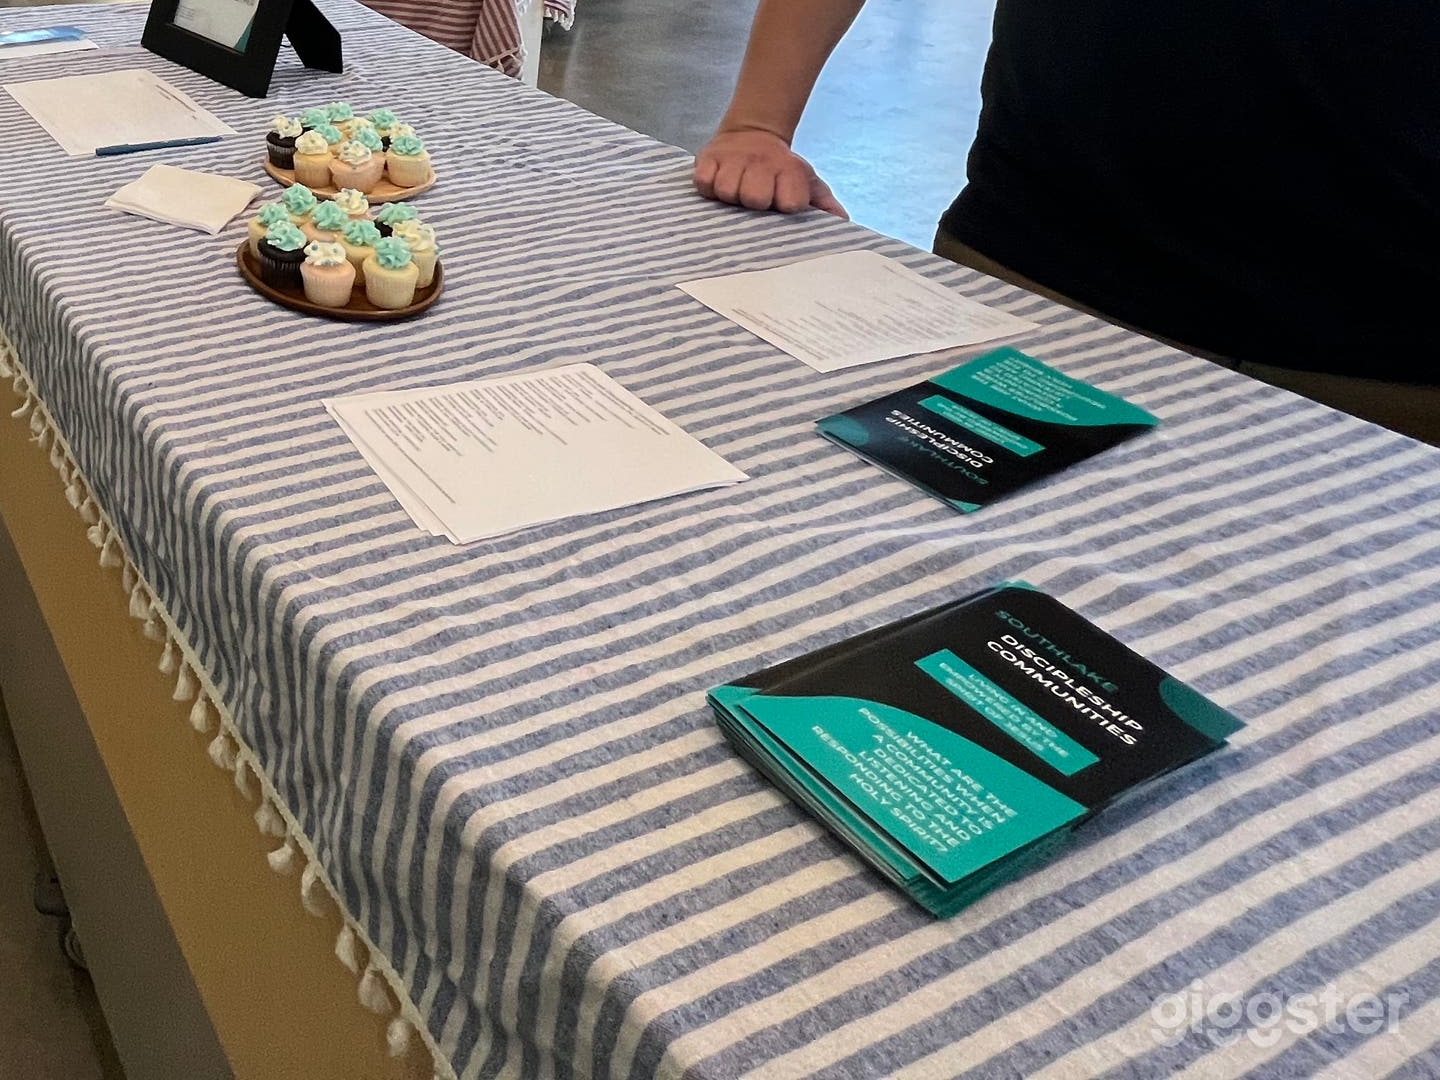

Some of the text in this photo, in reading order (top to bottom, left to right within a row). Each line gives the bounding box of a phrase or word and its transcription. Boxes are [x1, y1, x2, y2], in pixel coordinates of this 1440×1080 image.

[882, 414, 985, 468] DISCIPLESHIP
[888, 408, 996, 464] COMMUNITIES
[982, 639, 1140, 746] COMMUNITIES
[993, 609, 1120, 693] SOUTHLAKE
[998, 633, 1145, 732] DISCIPLESHIP
[936, 661, 1023, 723] EMPOWERED
[1040, 737, 1070, 758] THE
[1023, 715, 1059, 739] AND
[809, 724, 961, 848] RESPONDING TO THE
[846, 772, 893, 807] HOLY
[855, 706, 1007, 823] POSSIBILITIES WHEN
[856, 750, 973, 842] LISTENING AND
[870, 732, 996, 830] A COMMUNITY IS
[871, 747, 985, 836] DEDICATED TO
[903, 731, 1018, 818] WHAT ARE THE
